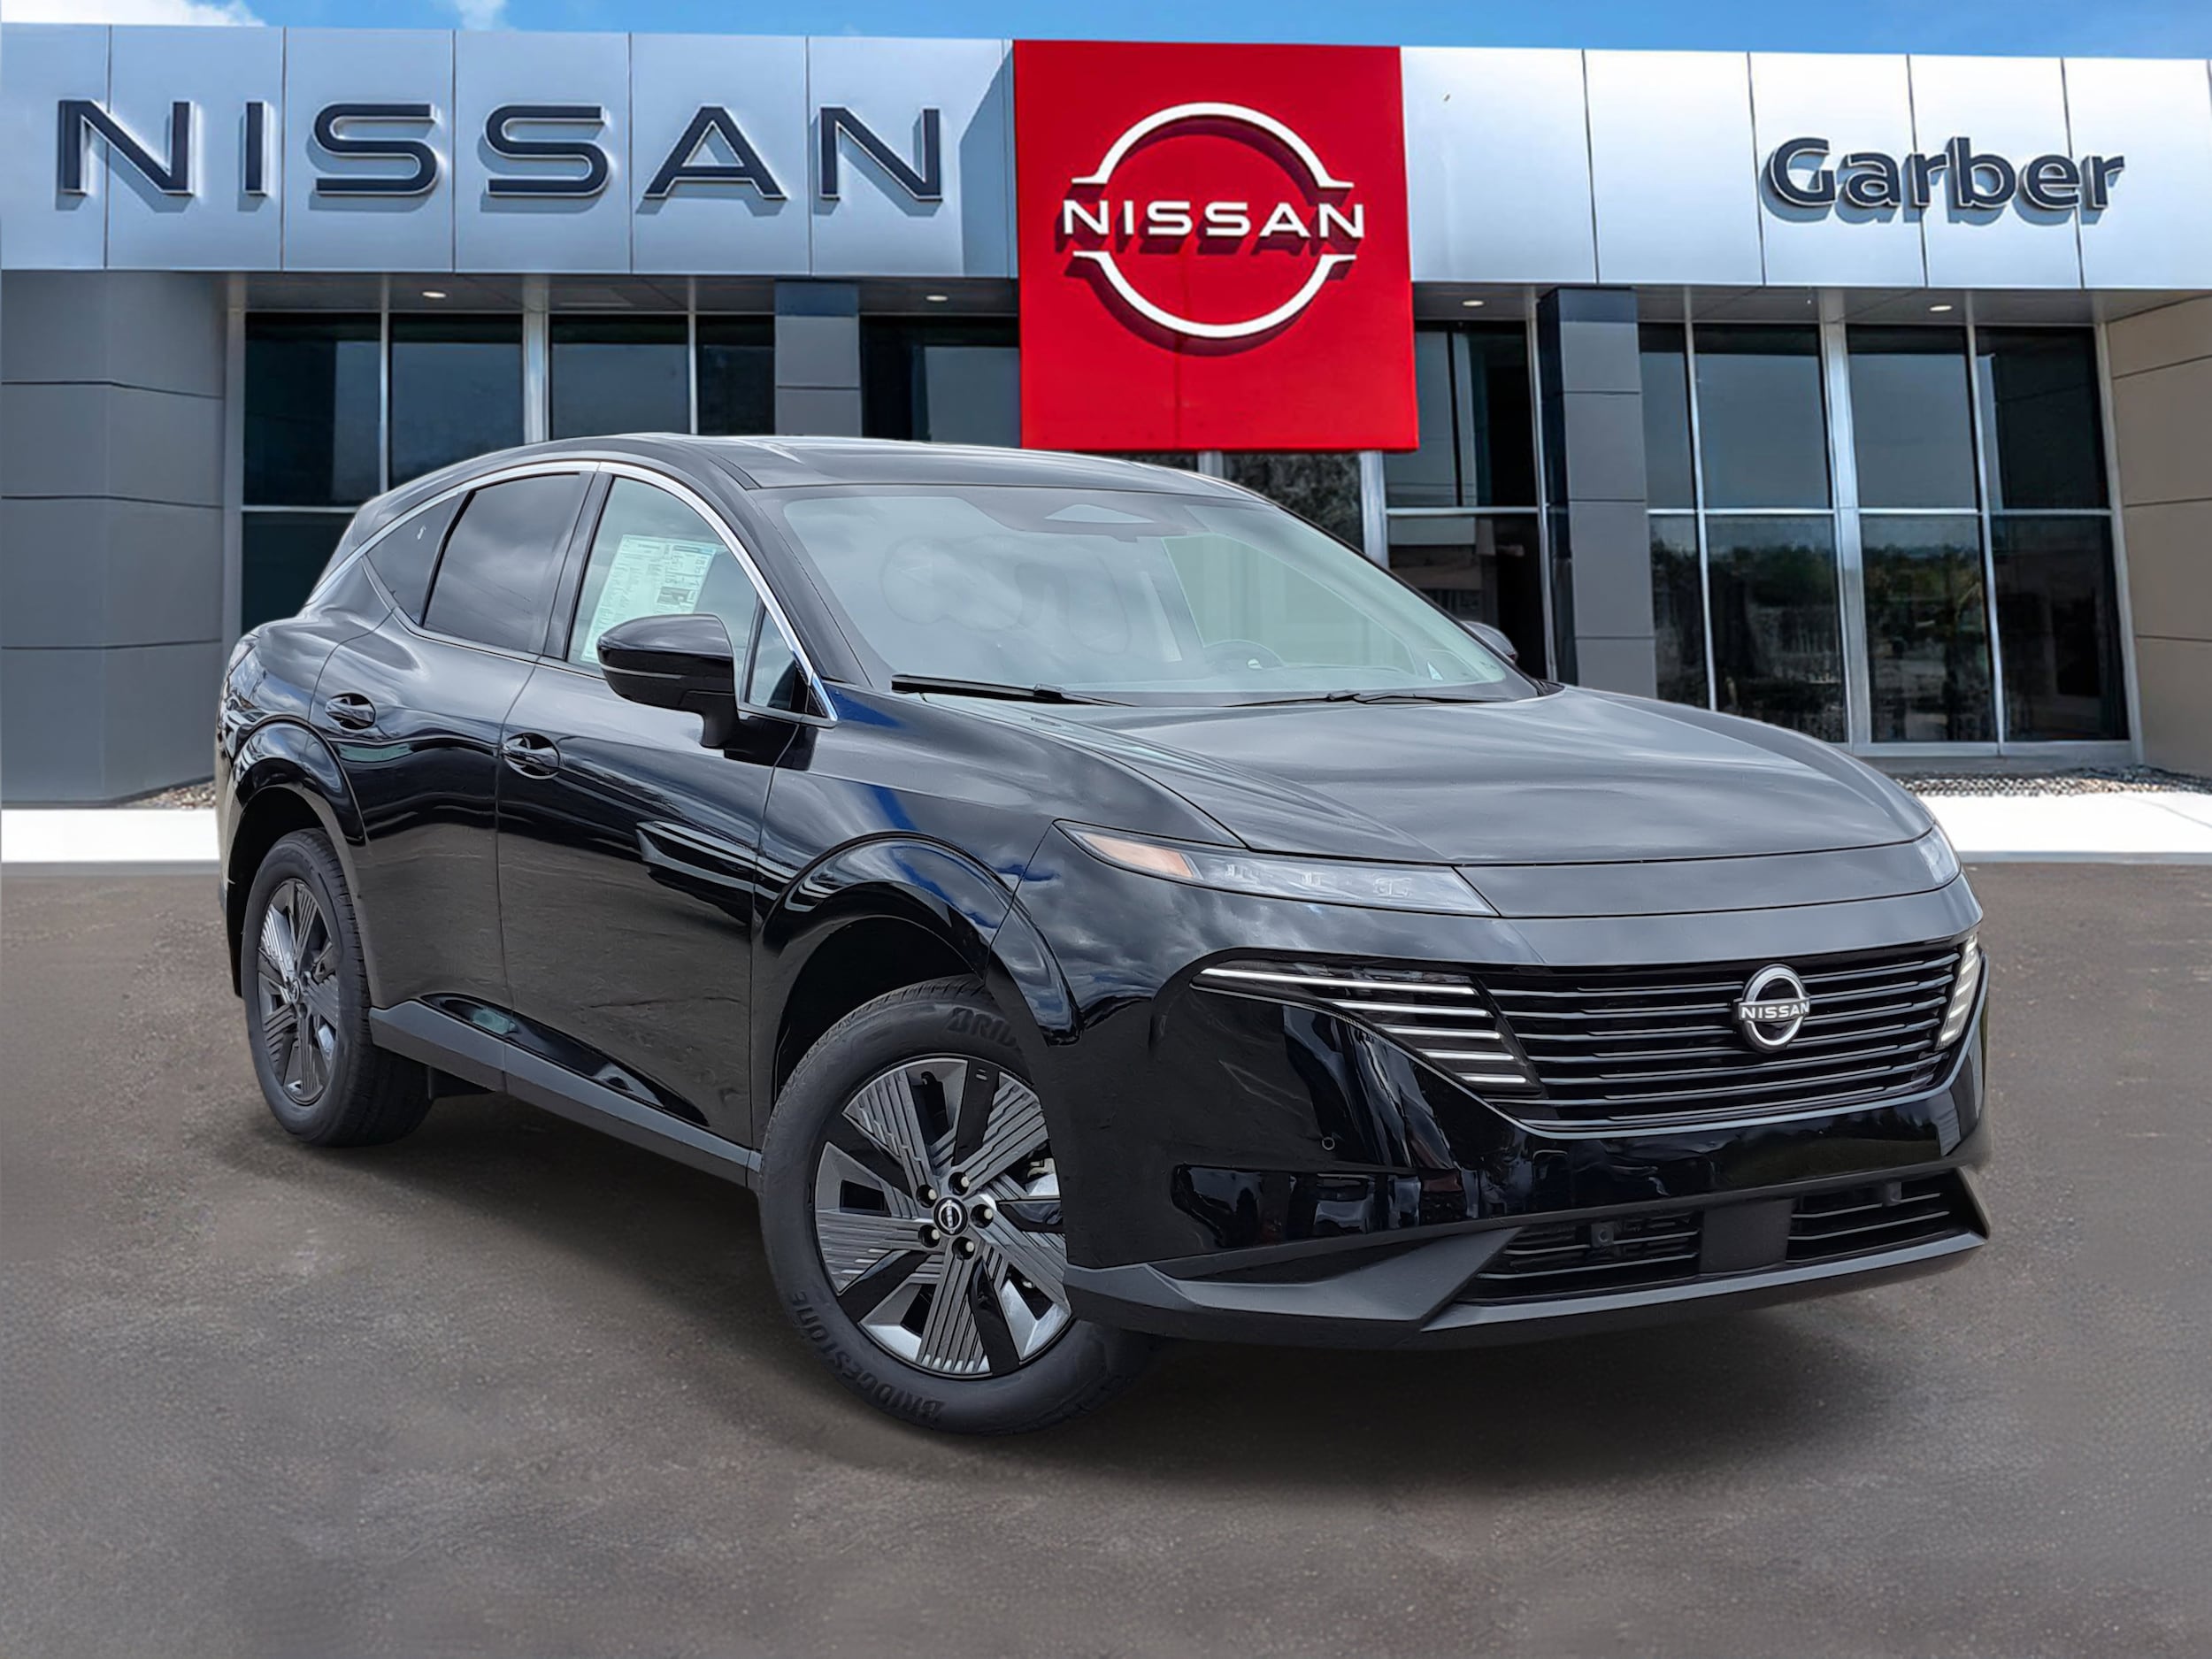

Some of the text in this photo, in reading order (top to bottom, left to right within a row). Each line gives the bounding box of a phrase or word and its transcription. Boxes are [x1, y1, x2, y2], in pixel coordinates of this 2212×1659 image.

[58, 99, 943, 202] NISSAN
[1768, 136, 2125, 211] Garber
[1063, 199, 1365, 238] NISSAN
[1741, 1002, 1809, 1019] NISSAN
[792, 1290, 947, 1428] BRIDGESTONE
